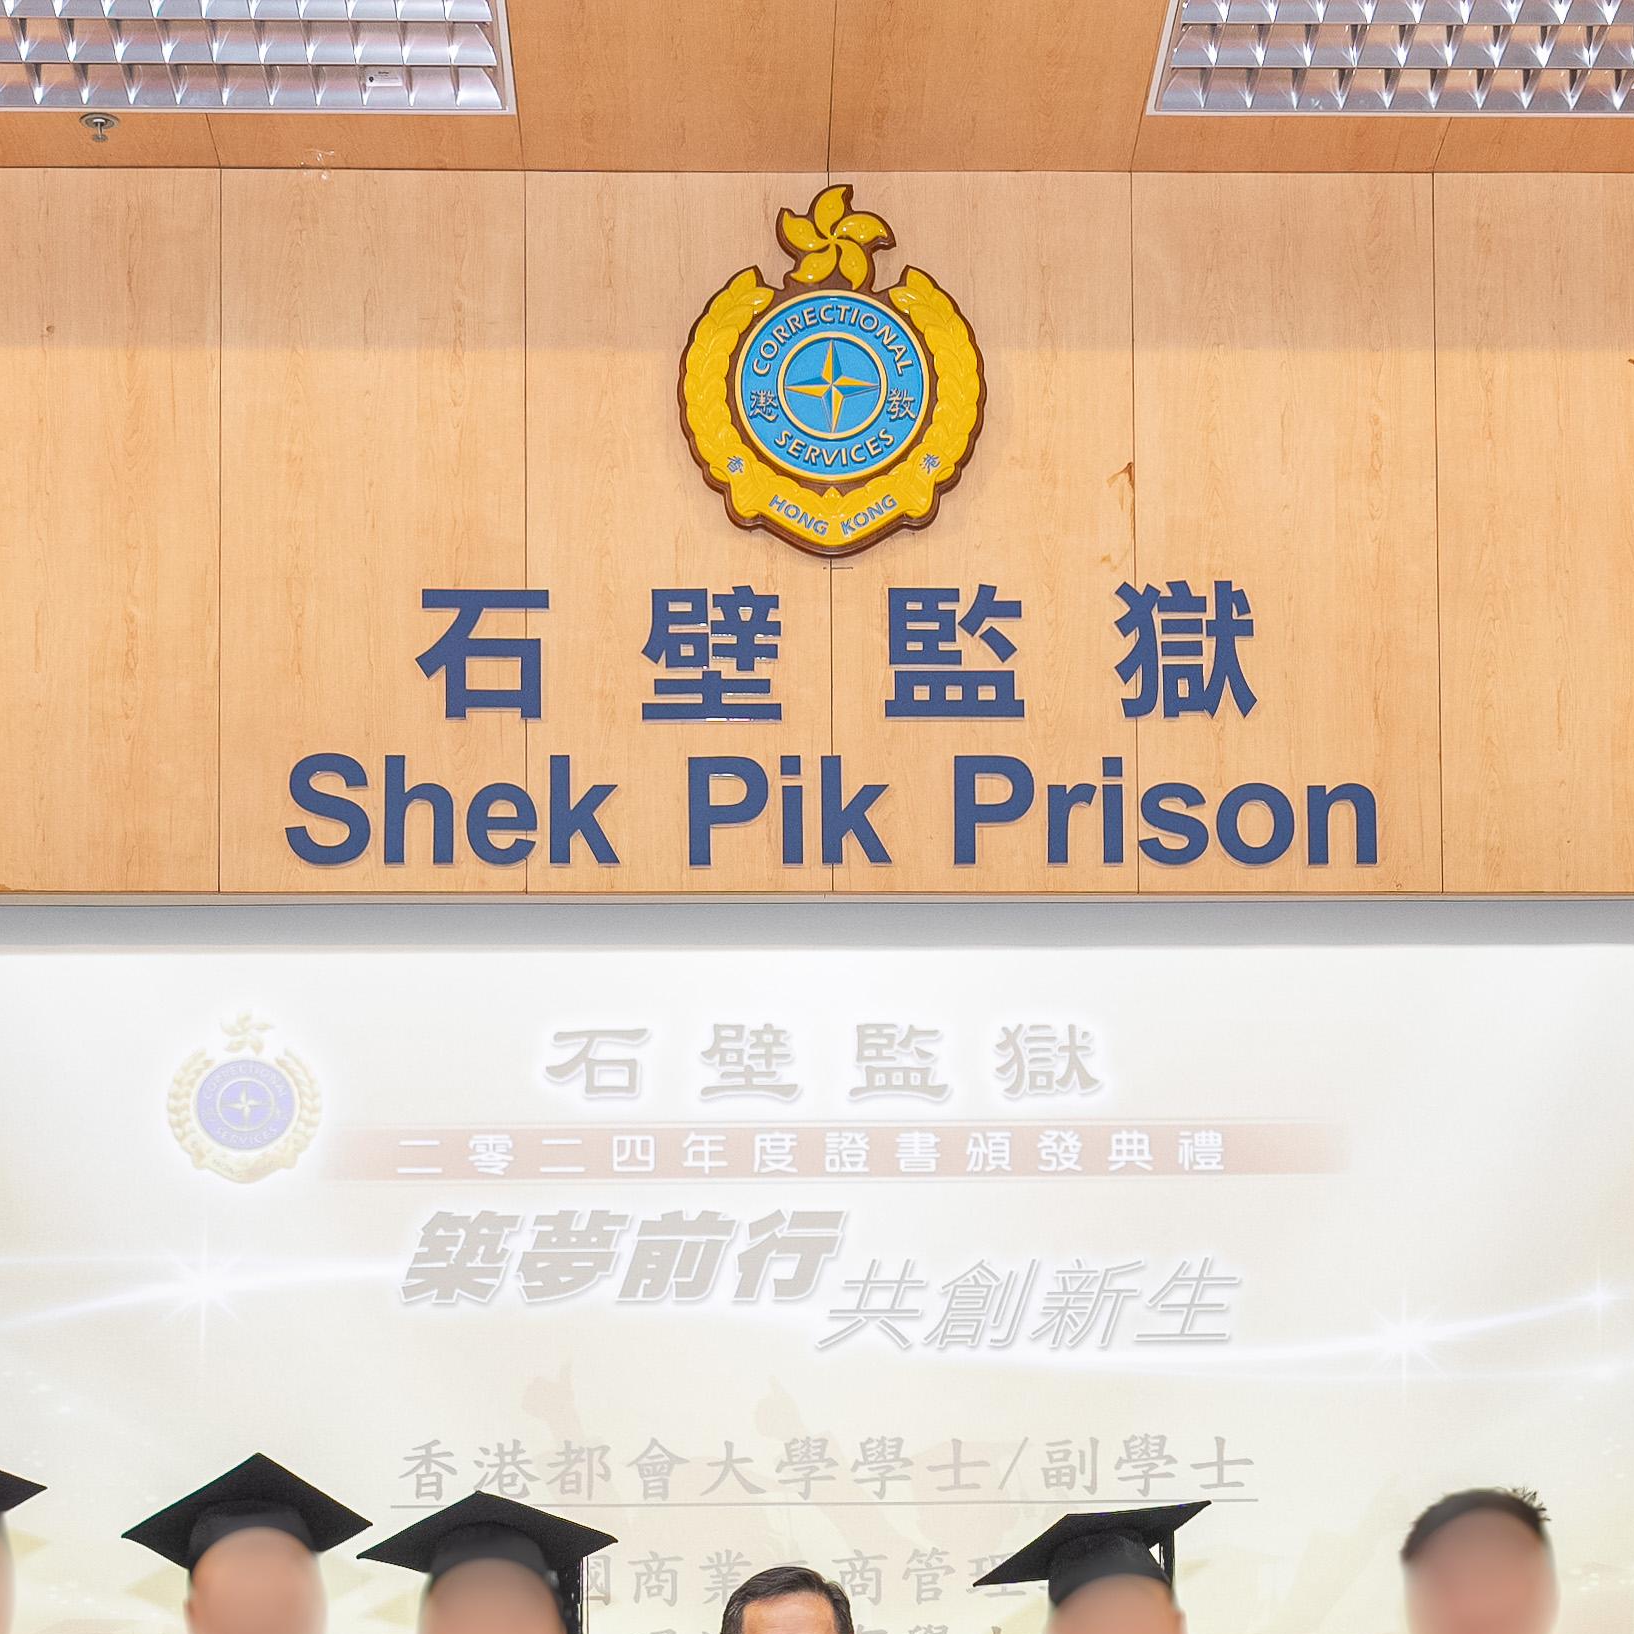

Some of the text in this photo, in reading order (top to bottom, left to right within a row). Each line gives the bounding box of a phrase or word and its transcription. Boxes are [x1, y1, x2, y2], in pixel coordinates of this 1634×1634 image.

[752, 304, 914, 375] CORRECTIONAL
[887, 387, 917, 422] 教
[774, 428, 896, 467] SERVICES
[768, 494, 898, 537] HONG KONG
[416, 580, 1256, 722] 石壁監獄
[285, 753, 1378, 867] Shek Pik Prison
[544, 1022, 1100, 1099] 石壁監獄
[397, 1129, 1226, 1176] 二零二四年度證書頒發典禮
[400, 1208, 848, 1305] 築夢前行
[815, 1256, 1242, 1350] 共創新生
[398, 1433, 1256, 1501] 香港都會大學學士/副學士
